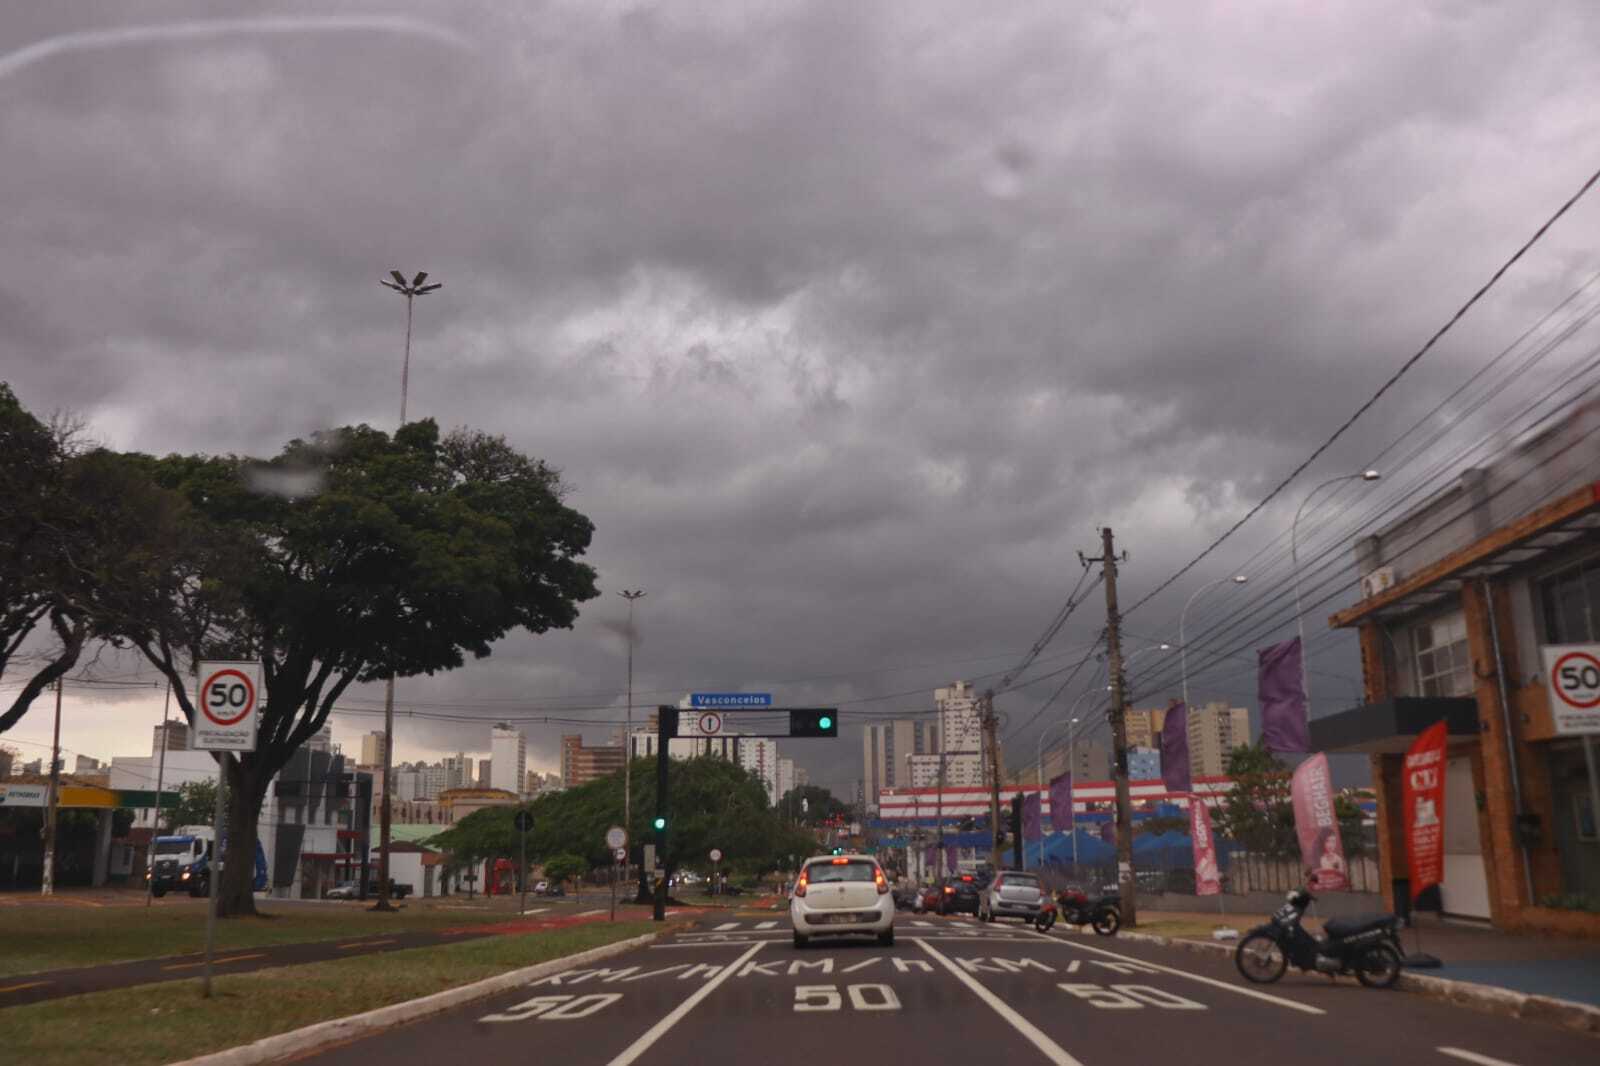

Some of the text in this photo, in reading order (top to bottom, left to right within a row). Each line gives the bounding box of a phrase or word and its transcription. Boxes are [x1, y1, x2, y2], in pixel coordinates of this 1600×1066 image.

[1561, 665, 1600, 690] 50
[209, 684, 247, 707] 50
[697, 695, 766, 705] Vasconcelos
[478, 993, 625, 1022] 50
[793, 984, 903, 1012] 50
[1056, 983, 1209, 1010] 50
